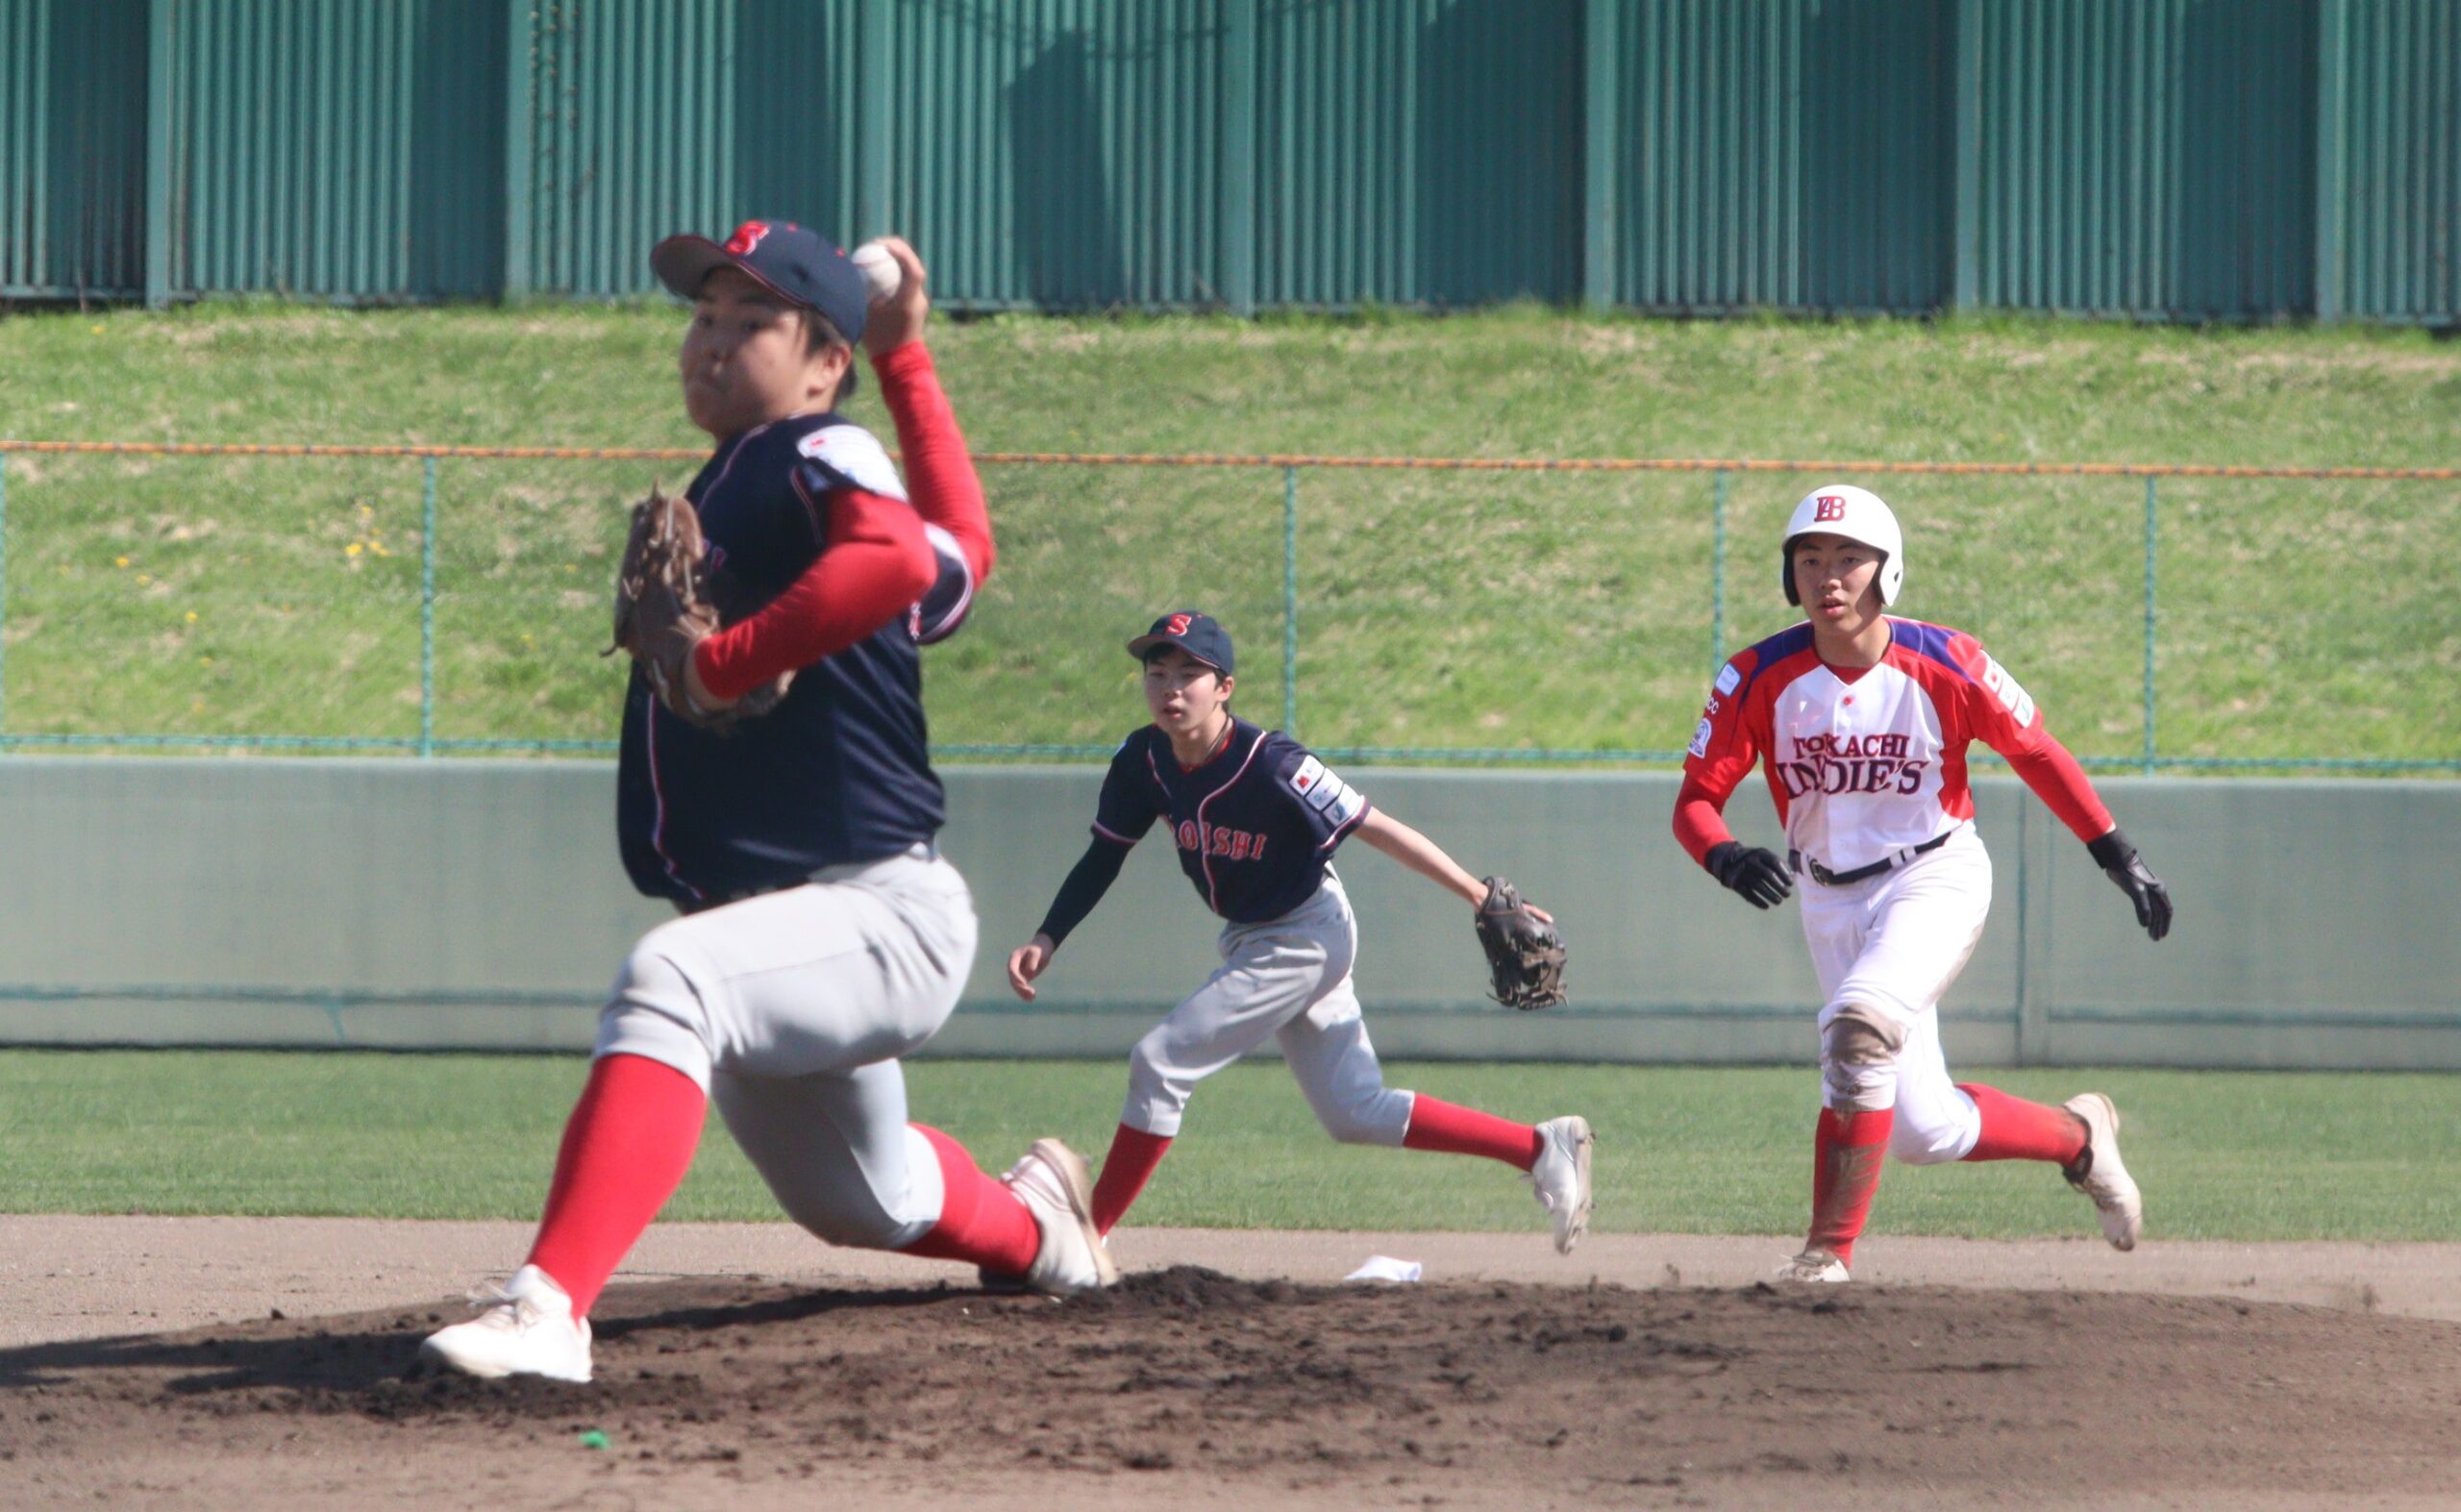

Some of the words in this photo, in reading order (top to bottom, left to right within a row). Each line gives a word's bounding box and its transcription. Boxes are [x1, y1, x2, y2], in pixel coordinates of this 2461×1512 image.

[725, 218, 770, 256] S
[1165, 614, 1192, 636] S
[1793, 732, 1910, 759] TOKACHI
[1777, 754, 1930, 800] INDIE'S
[1165, 816, 1267, 860] OISHI
